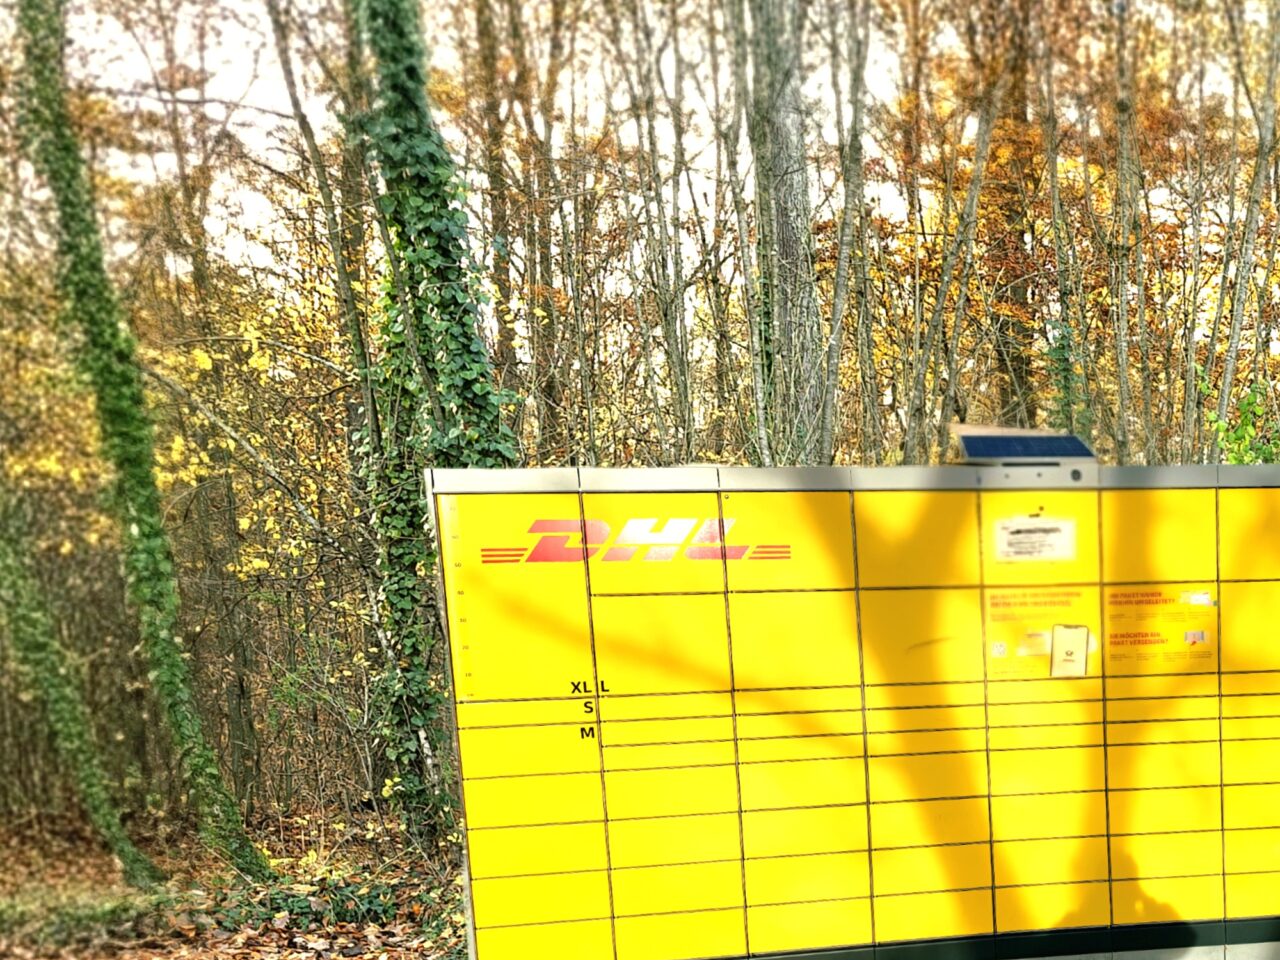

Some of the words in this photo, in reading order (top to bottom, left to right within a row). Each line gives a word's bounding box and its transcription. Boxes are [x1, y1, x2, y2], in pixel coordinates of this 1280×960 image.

[525, 518, 750, 563] DHL
[571, 681, 592, 694] XL
[600, 680, 609, 692] L
[584, 701, 593, 713] S
[580, 727, 595, 739] M
